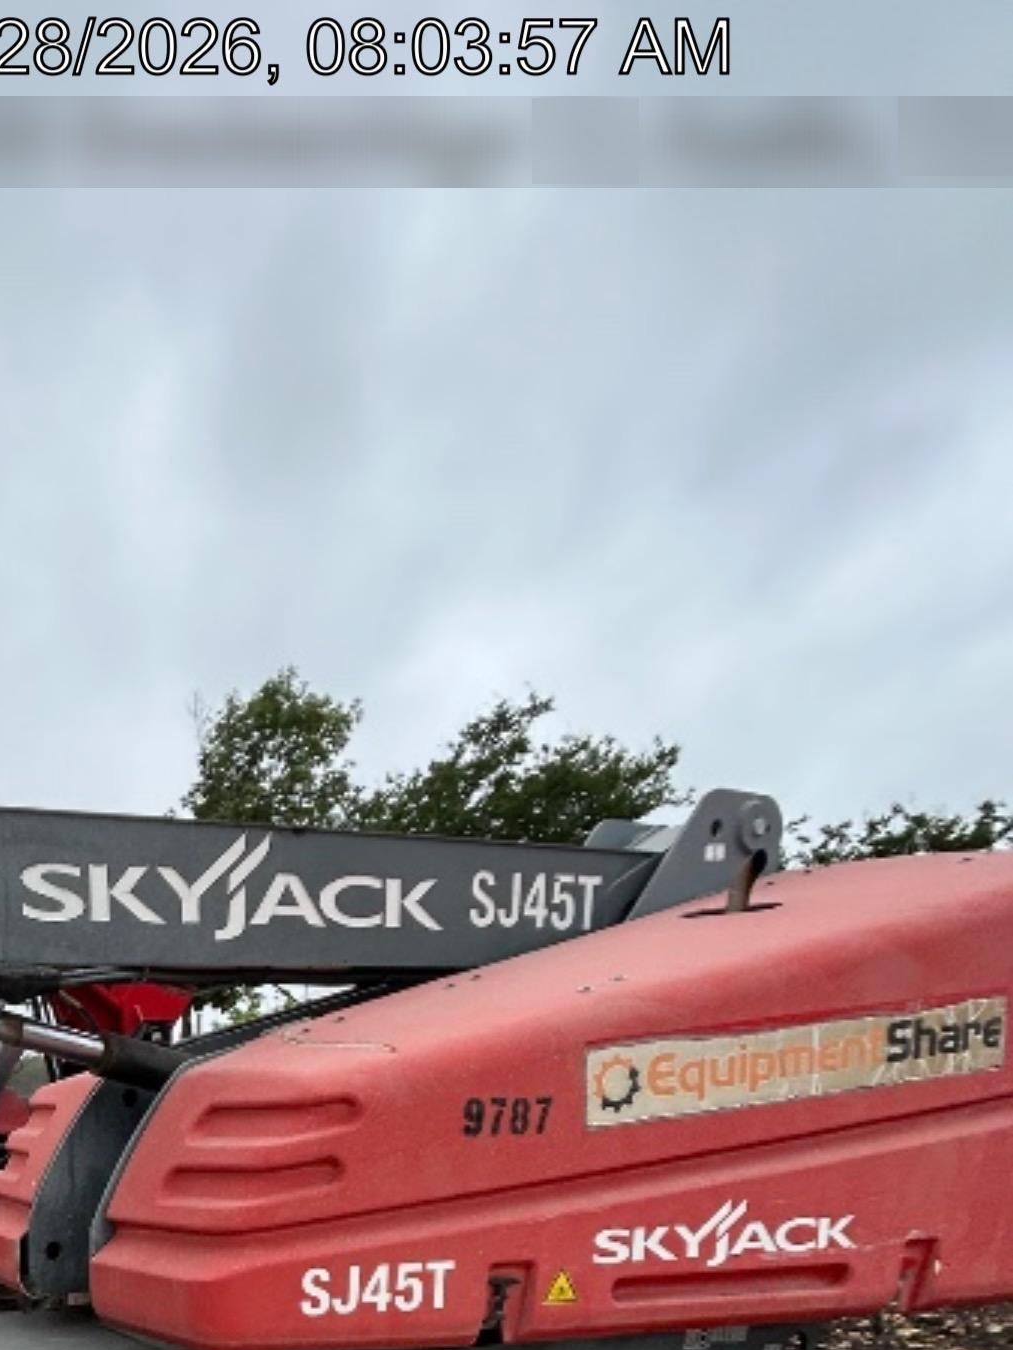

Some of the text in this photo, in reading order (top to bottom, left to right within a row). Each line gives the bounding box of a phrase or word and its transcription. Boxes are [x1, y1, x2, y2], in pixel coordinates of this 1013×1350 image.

[19, 832, 603, 940] SKYJACK SJ45T
[647, 1014, 1001, 1098] EquipmentShare
[463, 1096, 553, 1137] 9787
[592, 1200, 856, 1267] SKYJACK
[300, 1259, 456, 1316] SJ45T
